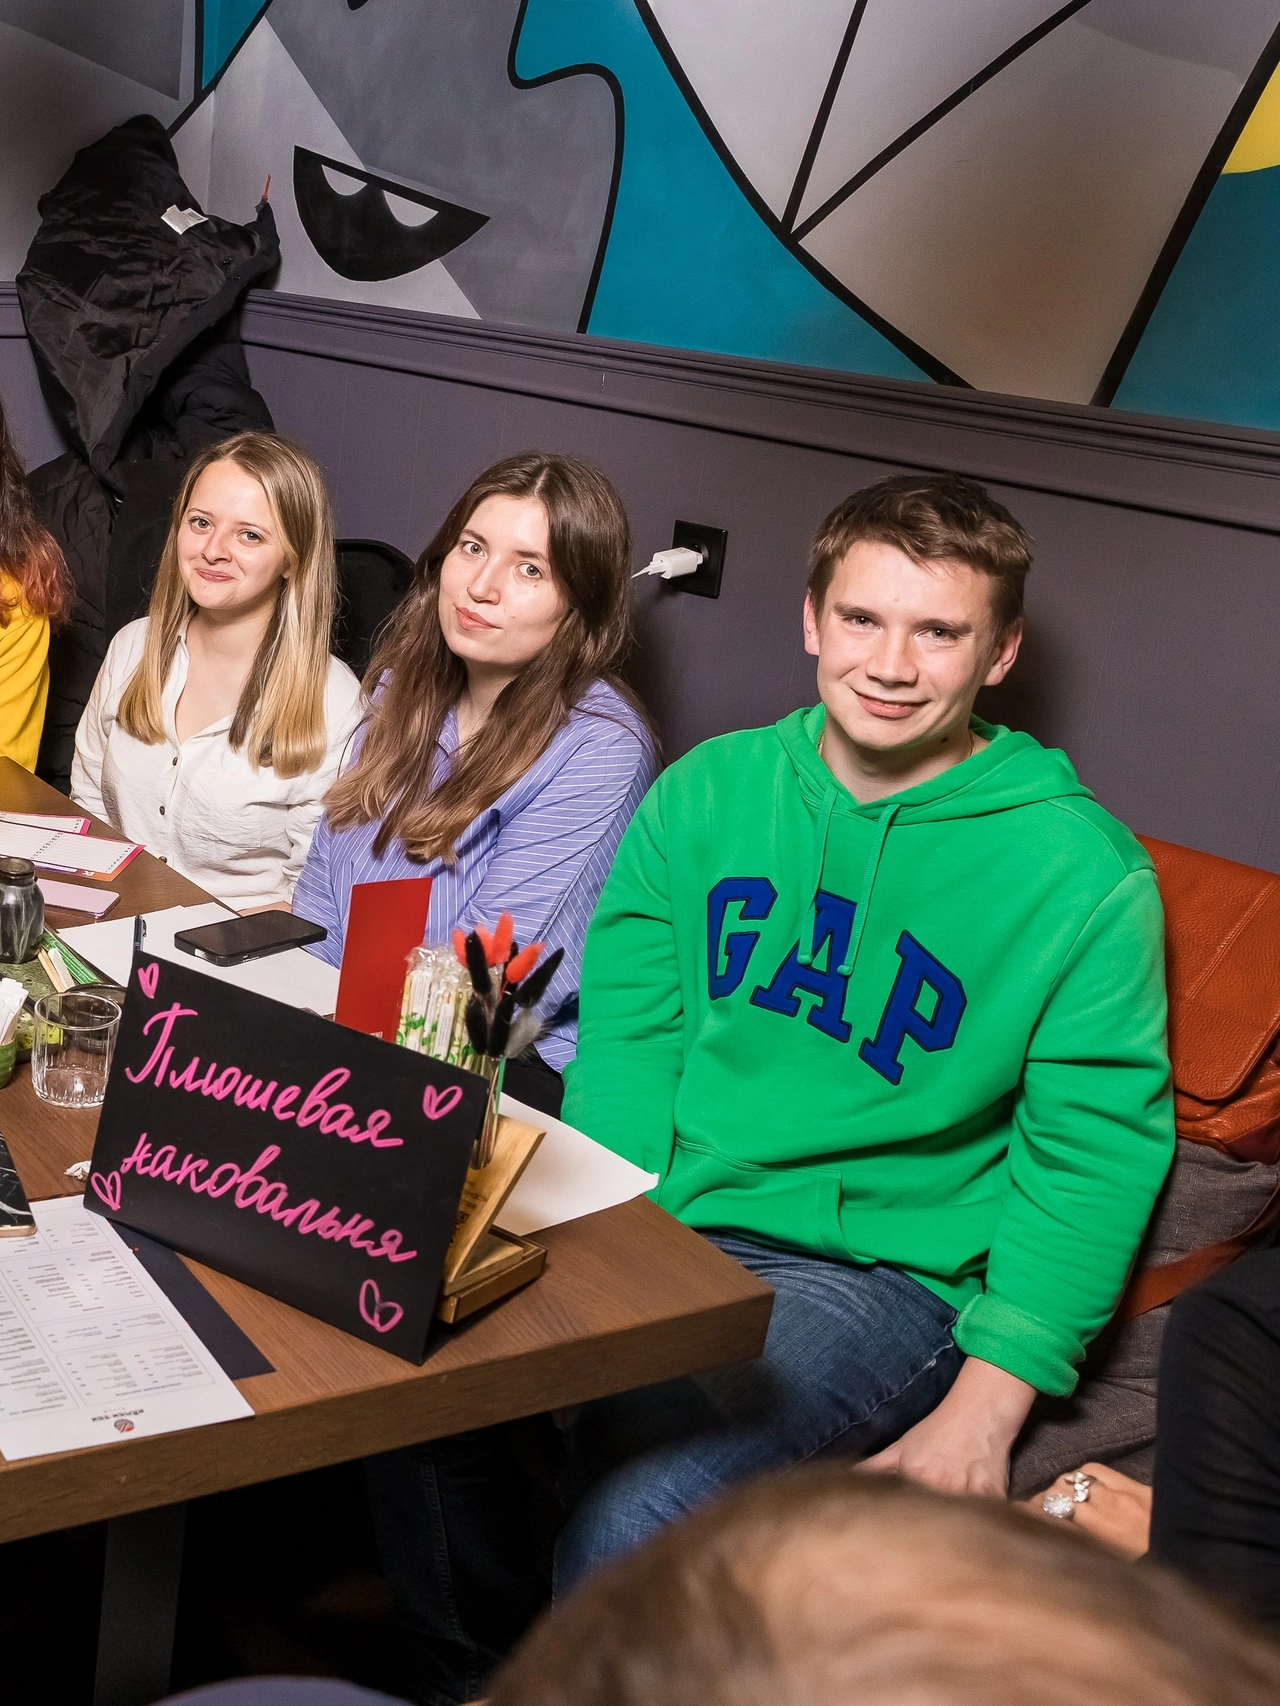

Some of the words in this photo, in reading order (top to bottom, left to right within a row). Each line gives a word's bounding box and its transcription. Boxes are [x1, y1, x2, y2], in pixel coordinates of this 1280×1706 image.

[707, 876, 968, 1086] GAP
[124, 1002, 404, 1148] Плюшевая
[120, 1132, 417, 1263] наковальня
